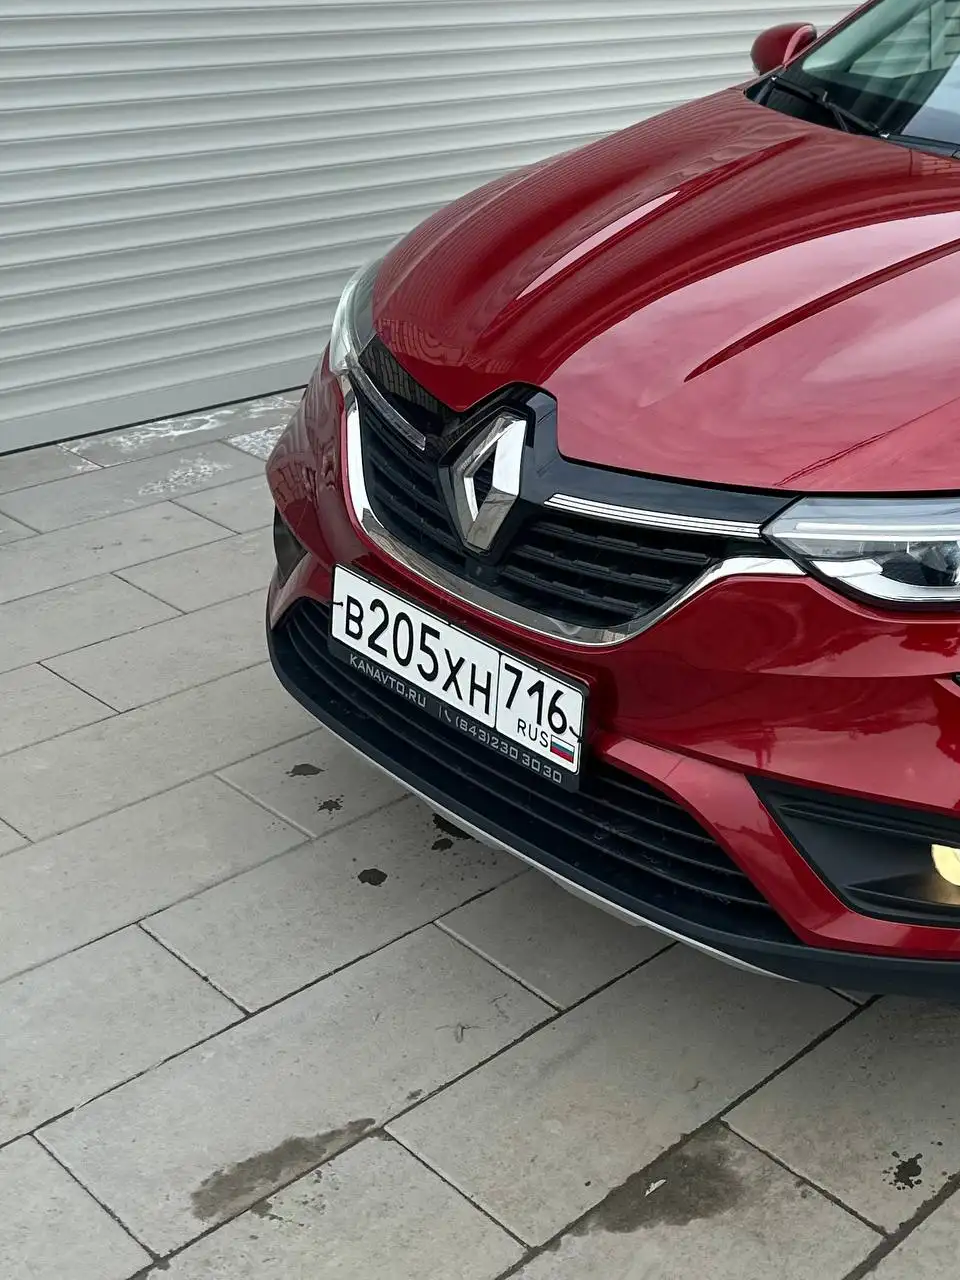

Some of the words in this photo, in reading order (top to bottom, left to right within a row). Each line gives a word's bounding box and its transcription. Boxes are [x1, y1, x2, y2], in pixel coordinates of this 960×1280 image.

[350, 654, 426, 708] KANAVTO.RU
[505, 663, 567, 735] 716
[517, 719, 549, 748] RUS
